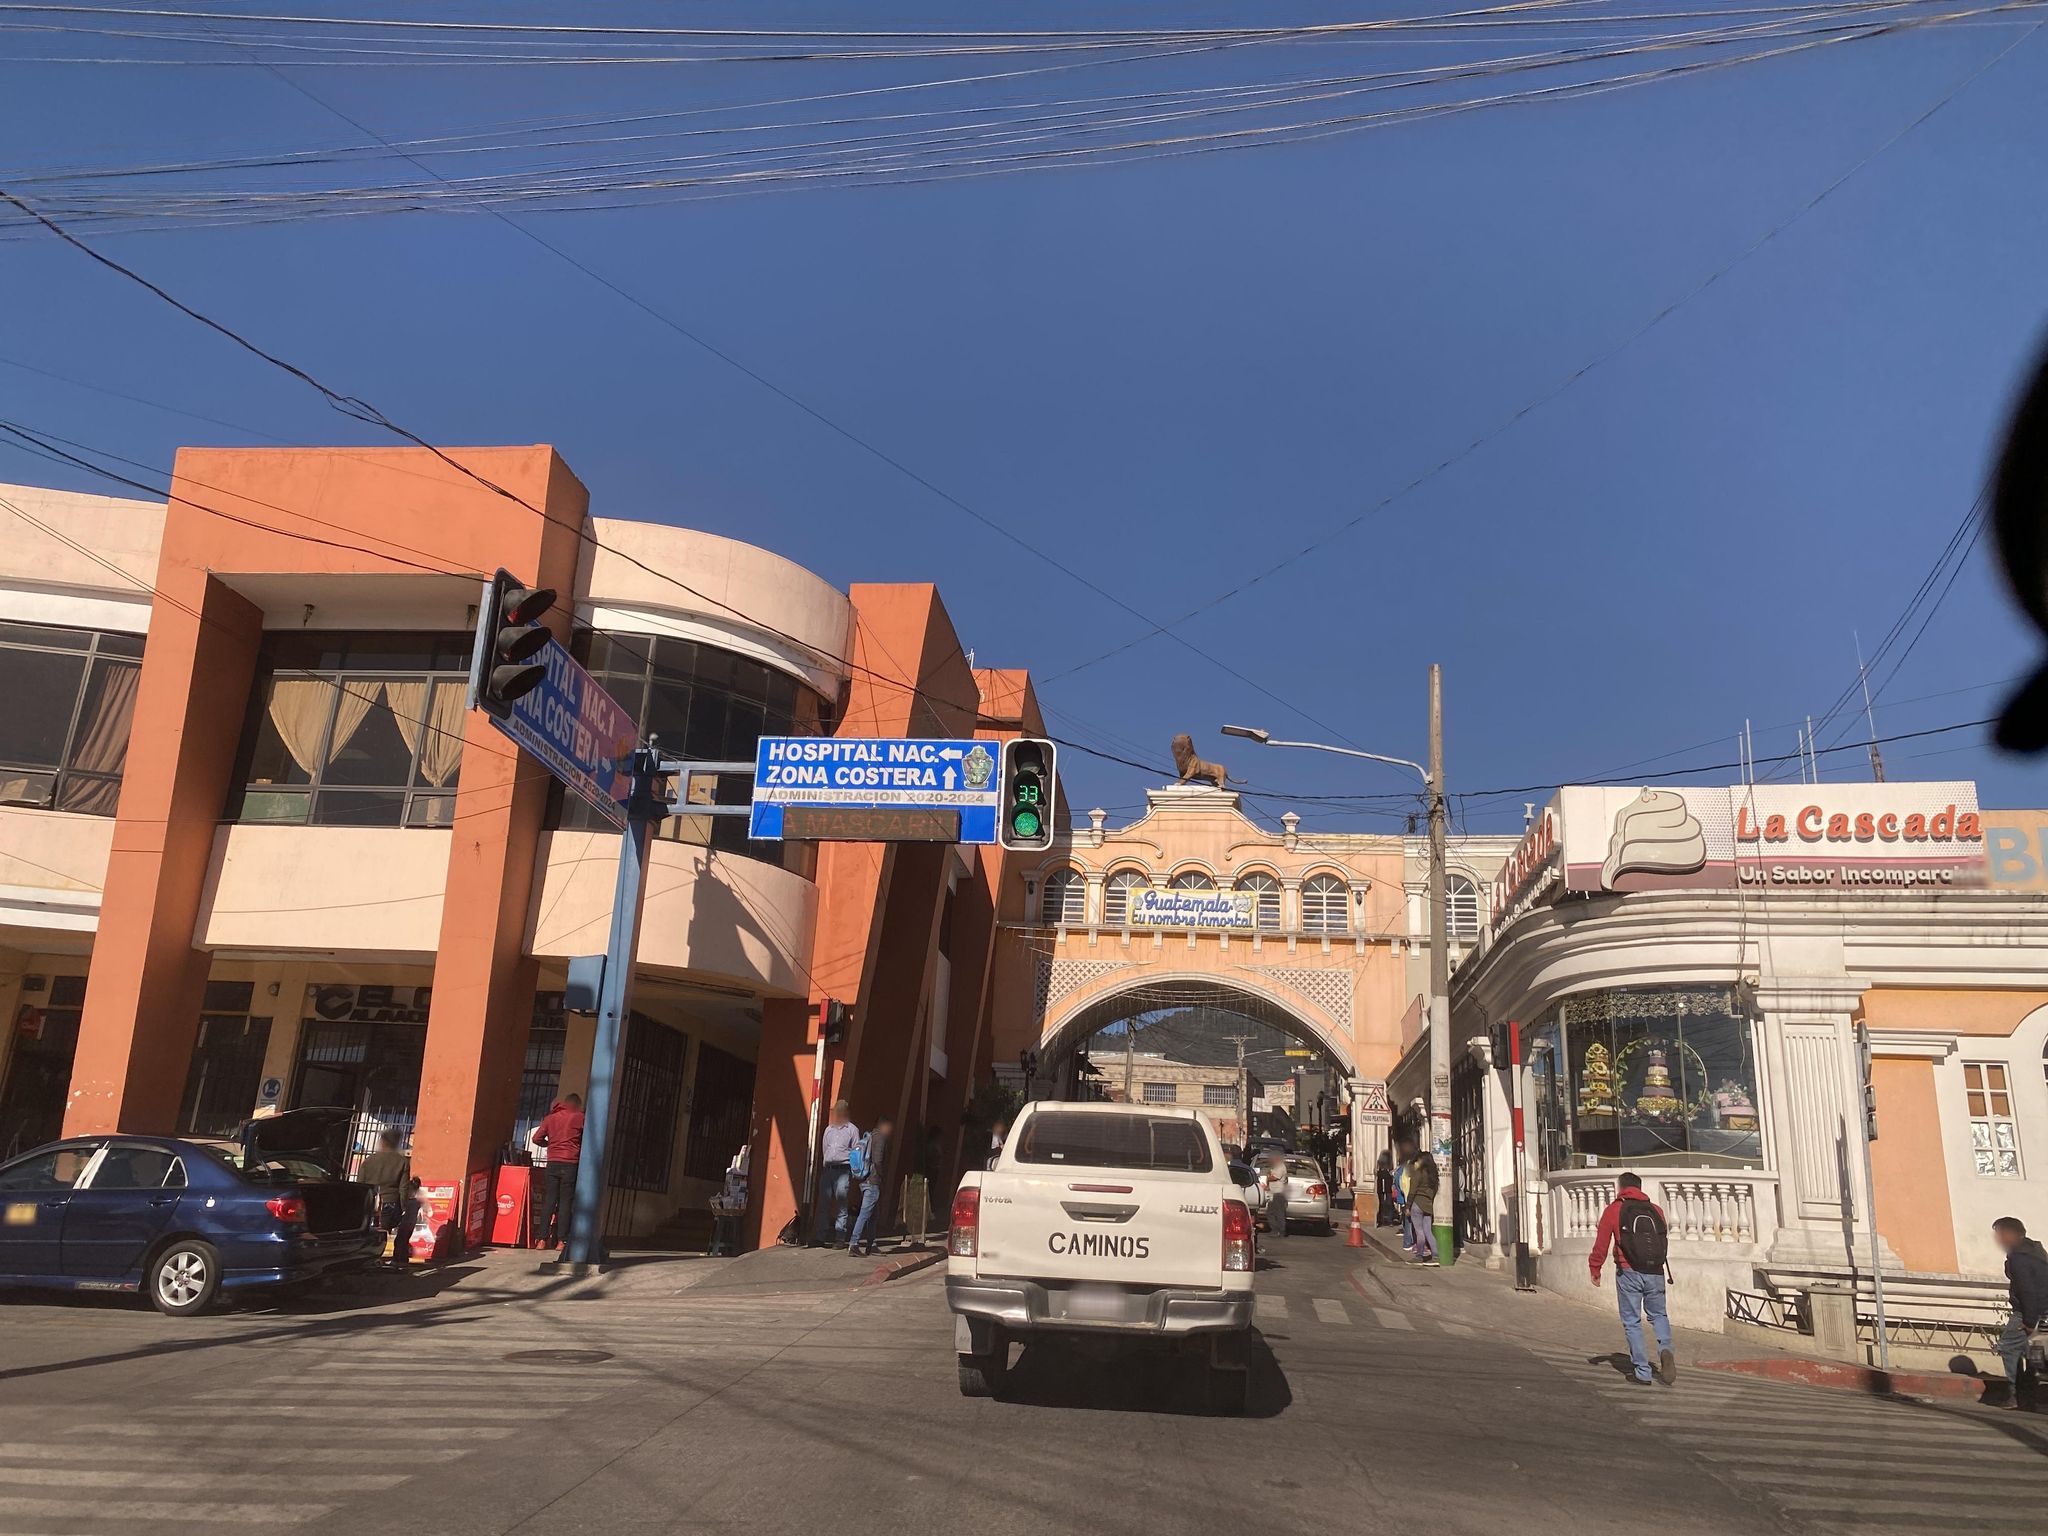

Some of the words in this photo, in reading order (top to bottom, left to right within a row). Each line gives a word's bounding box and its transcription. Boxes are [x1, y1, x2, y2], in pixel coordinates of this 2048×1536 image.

[581, 681, 606, 736] NAC.
[545, 695, 600, 774] COSTERA
[768, 742, 883, 763] HOSPITAL
[888, 744, 939, 764] NAC.
[513, 720, 582, 786] ADMINISTRACION
[583, 776, 616, 811] 2020-2024
[766, 766, 829, 784] ZONA
[835, 767, 937, 787] COSTERA
[764, 789, 901, 802] ADMINISTRACION
[906, 792, 985, 804] 2020-2024
[1018, 785, 1039, 802] 33
[1736, 806, 1789, 842] La
[1796, 804, 1984, 842] Cascada
[1740, 865, 1767, 885] Un
[1771, 865, 1835, 885] Sabor
[1144, 890, 1233, 913] Guatemala
[1132, 909, 1146, 924] tu
[1148, 911, 1196, 927] nombre
[984, 1196, 1013, 1204] TOYOTA
[1179, 1204, 1219, 1215] HILUX
[1048, 1232, 1150, 1259] CAMINOS
